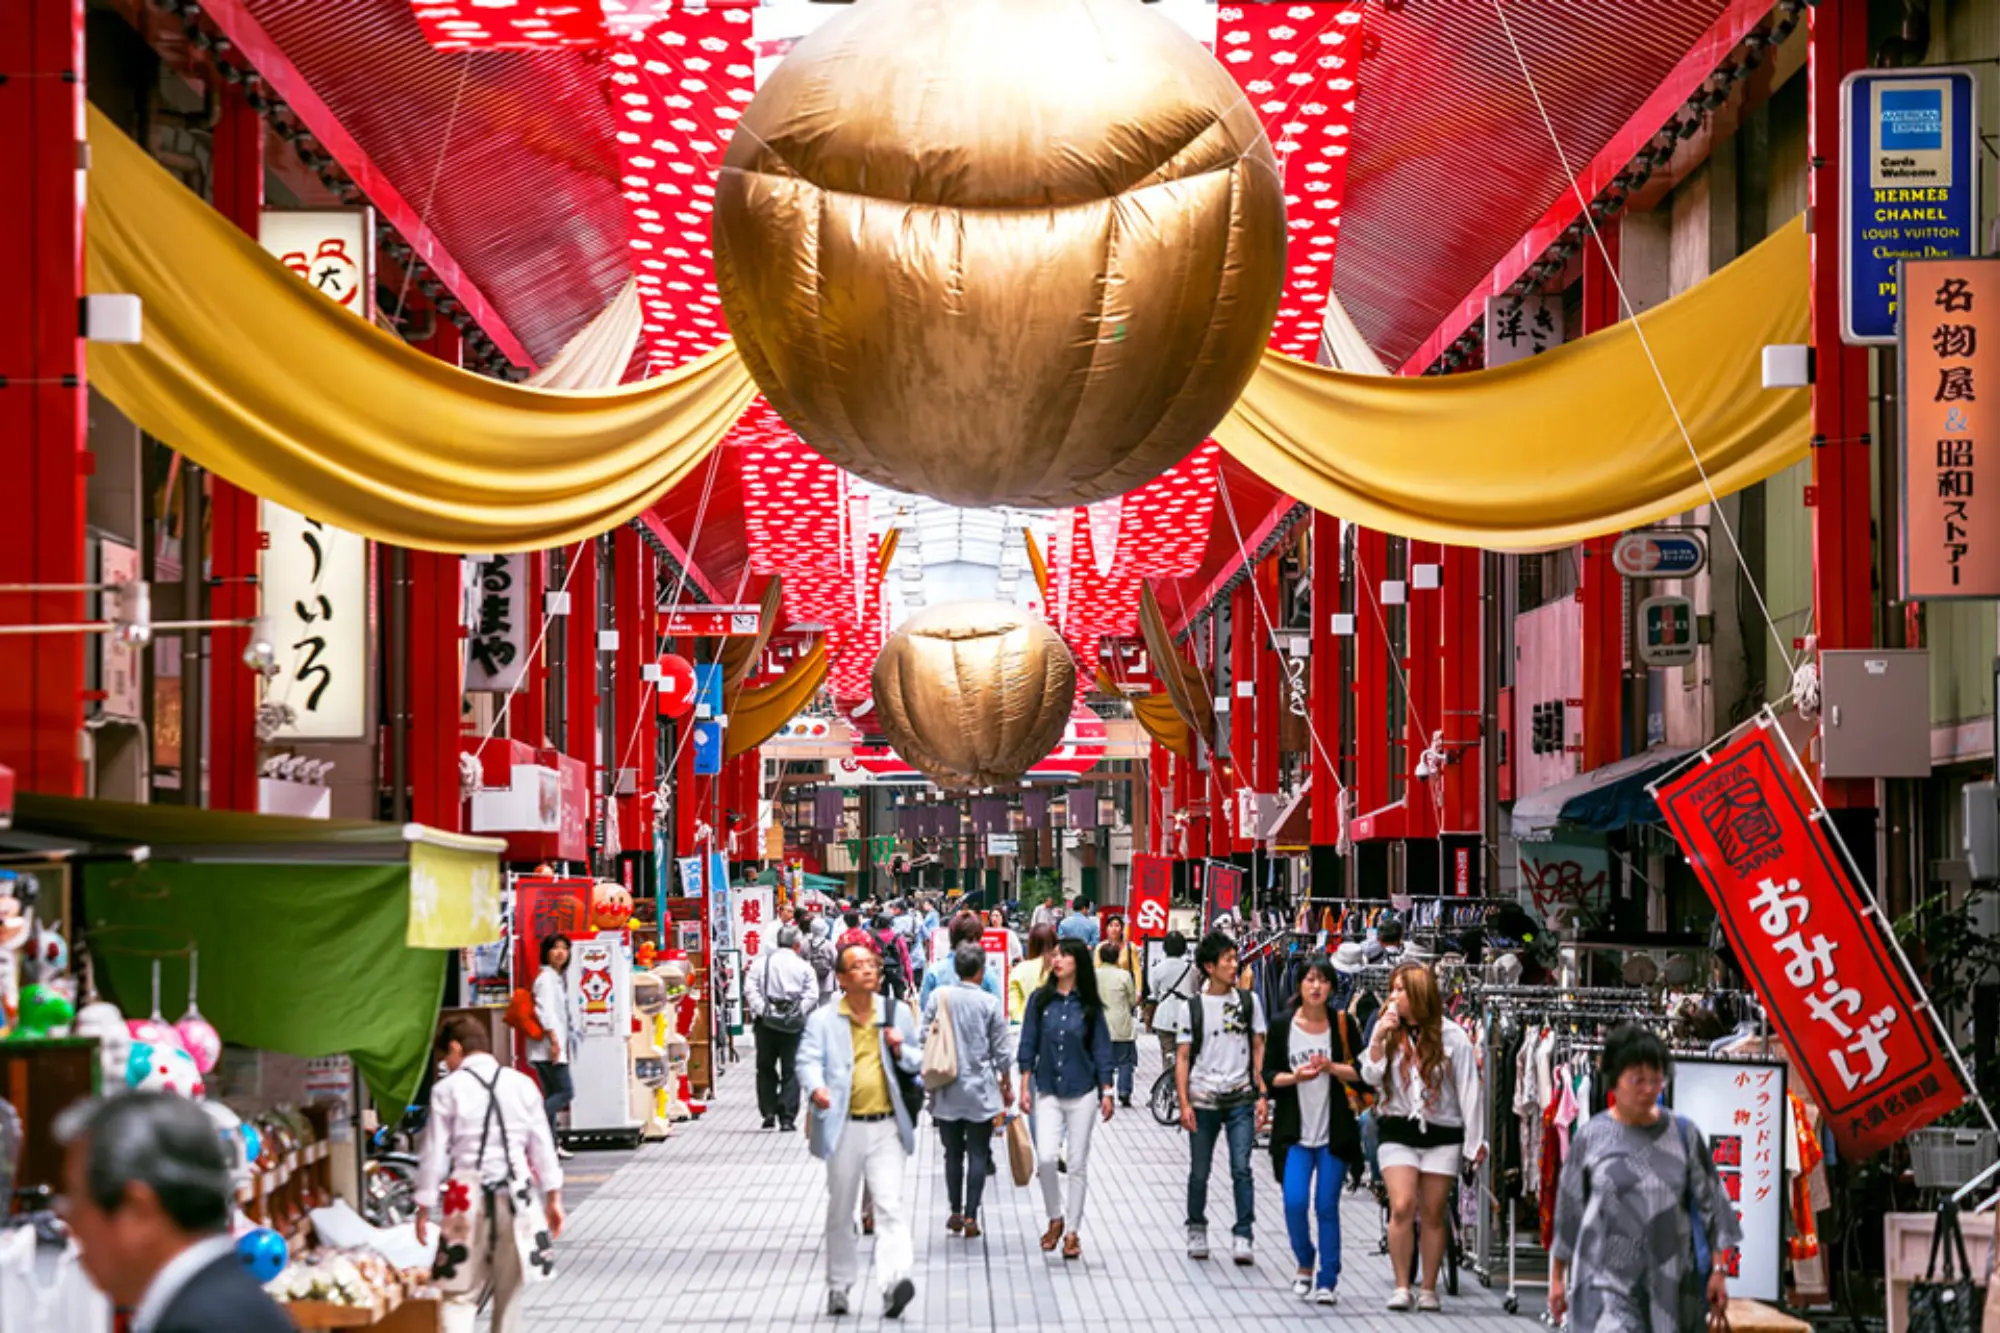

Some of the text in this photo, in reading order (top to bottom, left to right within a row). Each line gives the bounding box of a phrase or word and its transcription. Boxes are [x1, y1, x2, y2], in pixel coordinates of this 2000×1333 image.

[1880, 155, 1916, 168] Cards
[1880, 167, 1938, 179] Welcome
[1874, 207, 1949, 222] CHANEL
[1861, 225, 1961, 241] LOUIS VUITTON
[317, 265, 342, 291] 大
[1649, 619, 1689, 633] JCB
[1689, 762, 1751, 807] NAGOYA
[1733, 842, 1785, 880] JAPAN
[1748, 876, 1898, 1093] おみやげ
